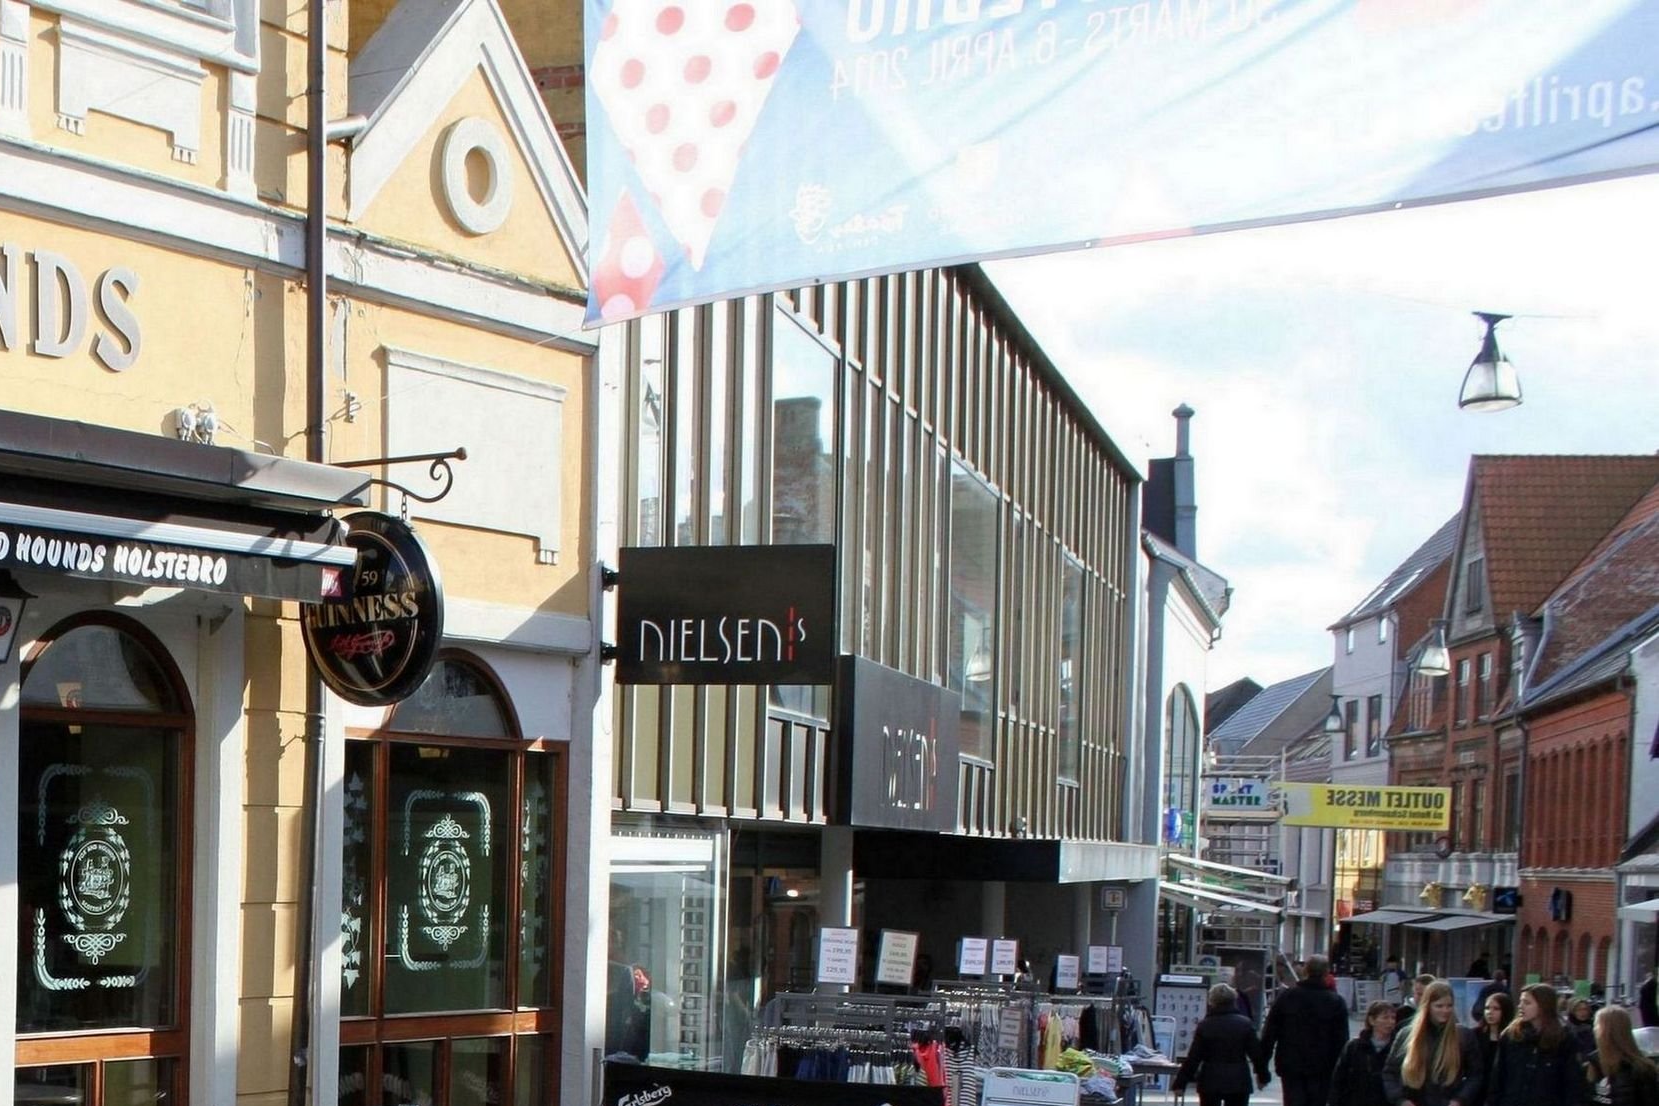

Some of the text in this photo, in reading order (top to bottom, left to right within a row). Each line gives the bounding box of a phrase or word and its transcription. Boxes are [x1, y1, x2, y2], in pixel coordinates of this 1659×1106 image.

[15, 533, 108, 573] HOUNDS
[114, 546, 228, 586] HOLSTEBRO
[361, 570, 379, 587] 59
[1211, 796, 1261, 806] MASTER
